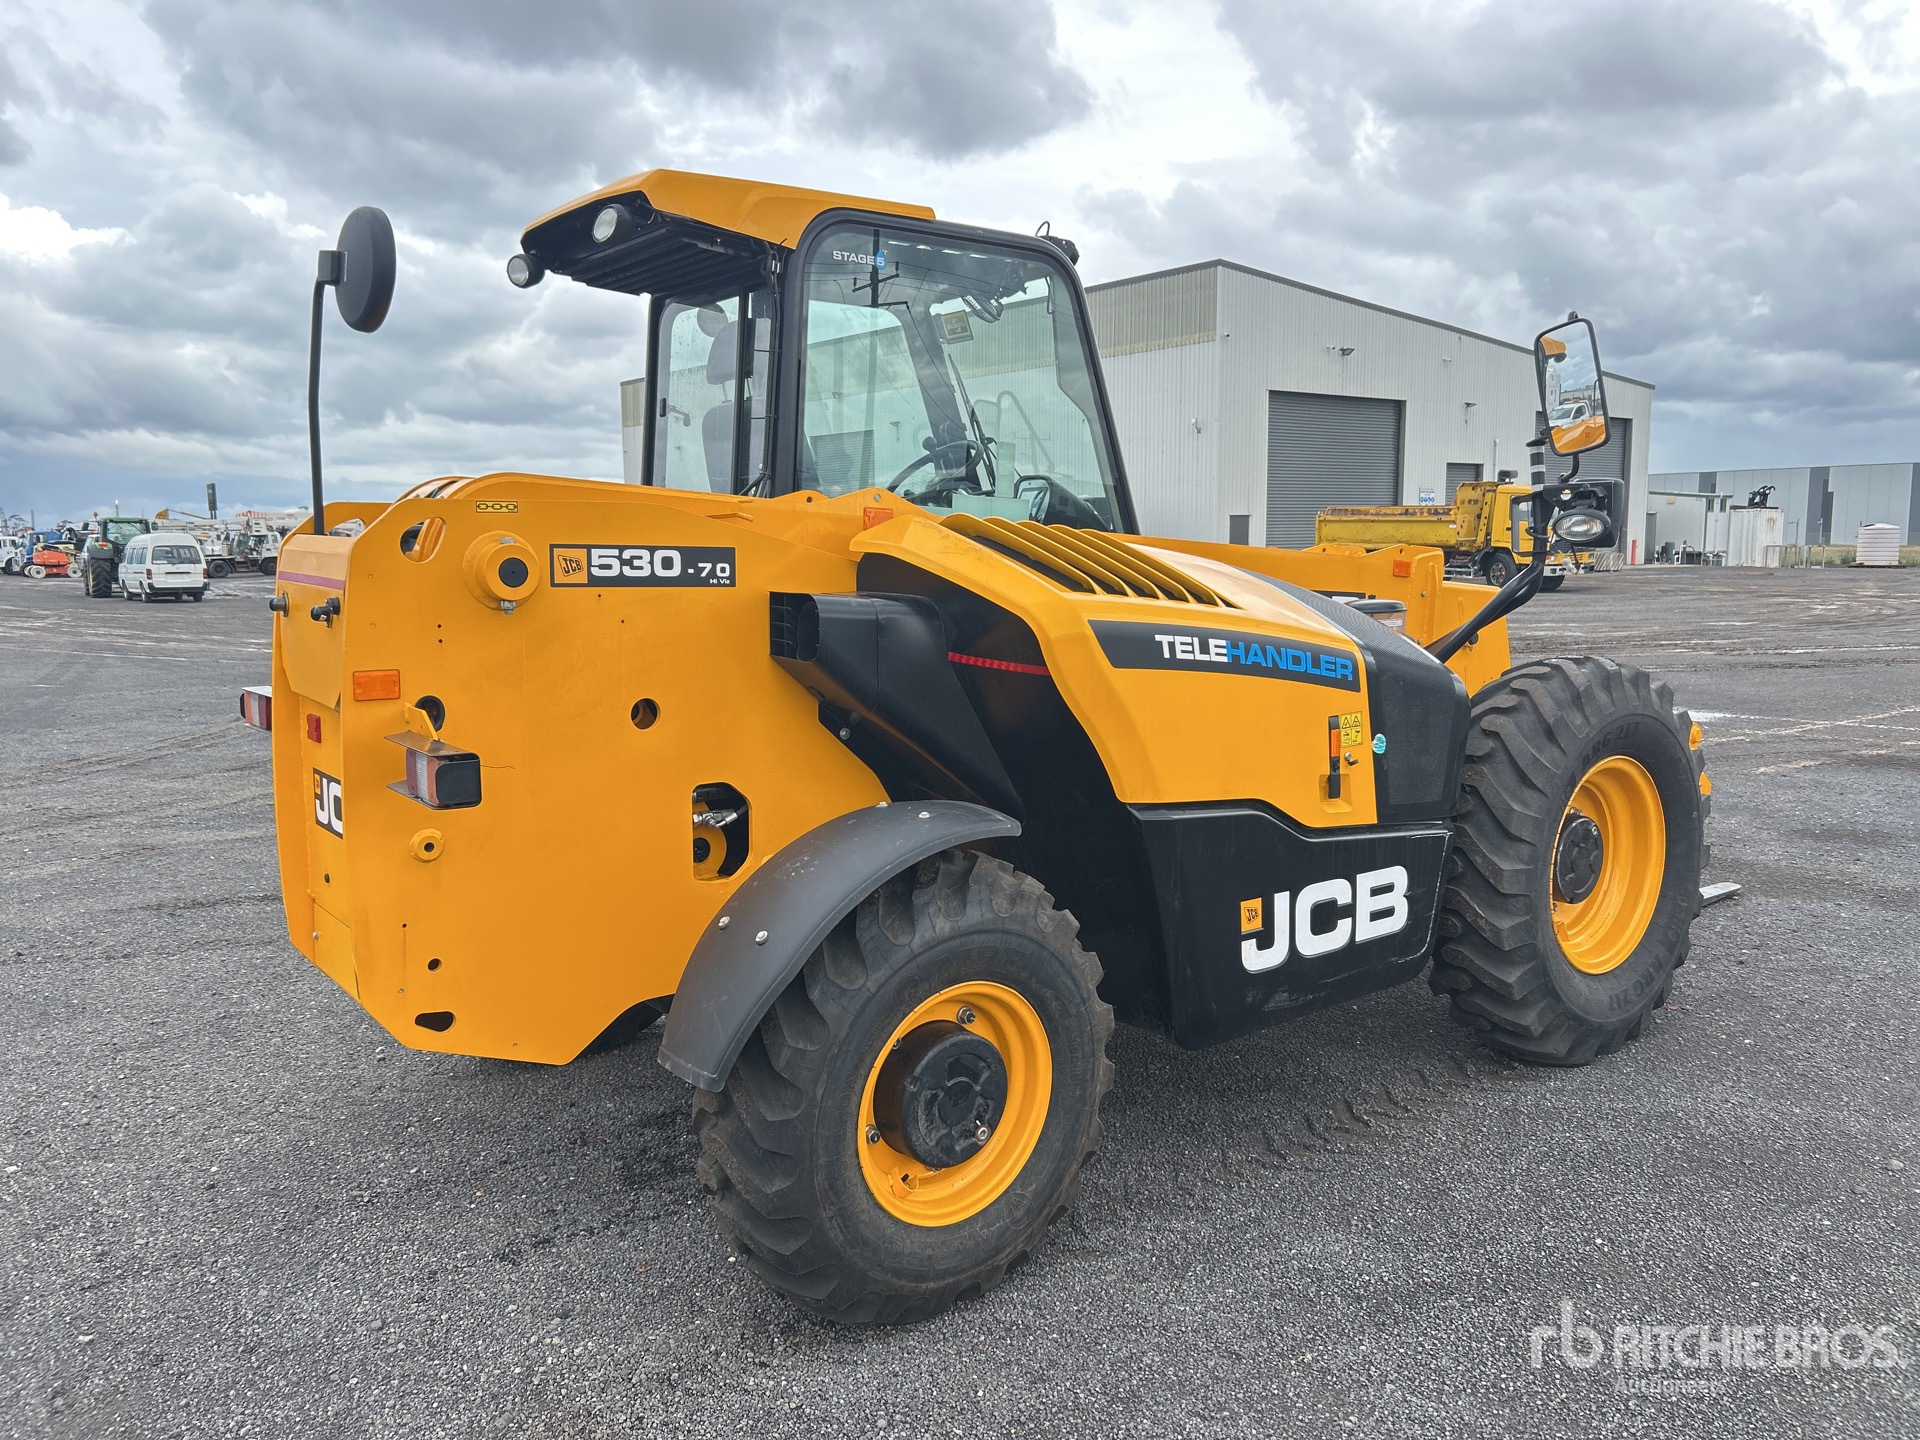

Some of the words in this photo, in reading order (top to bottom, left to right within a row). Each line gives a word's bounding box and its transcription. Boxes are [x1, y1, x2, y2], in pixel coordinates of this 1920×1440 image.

[561, 557, 583, 575] JCB
[1154, 634, 1353, 681] TELEHANDLER
[1241, 865, 1409, 972] JCB
